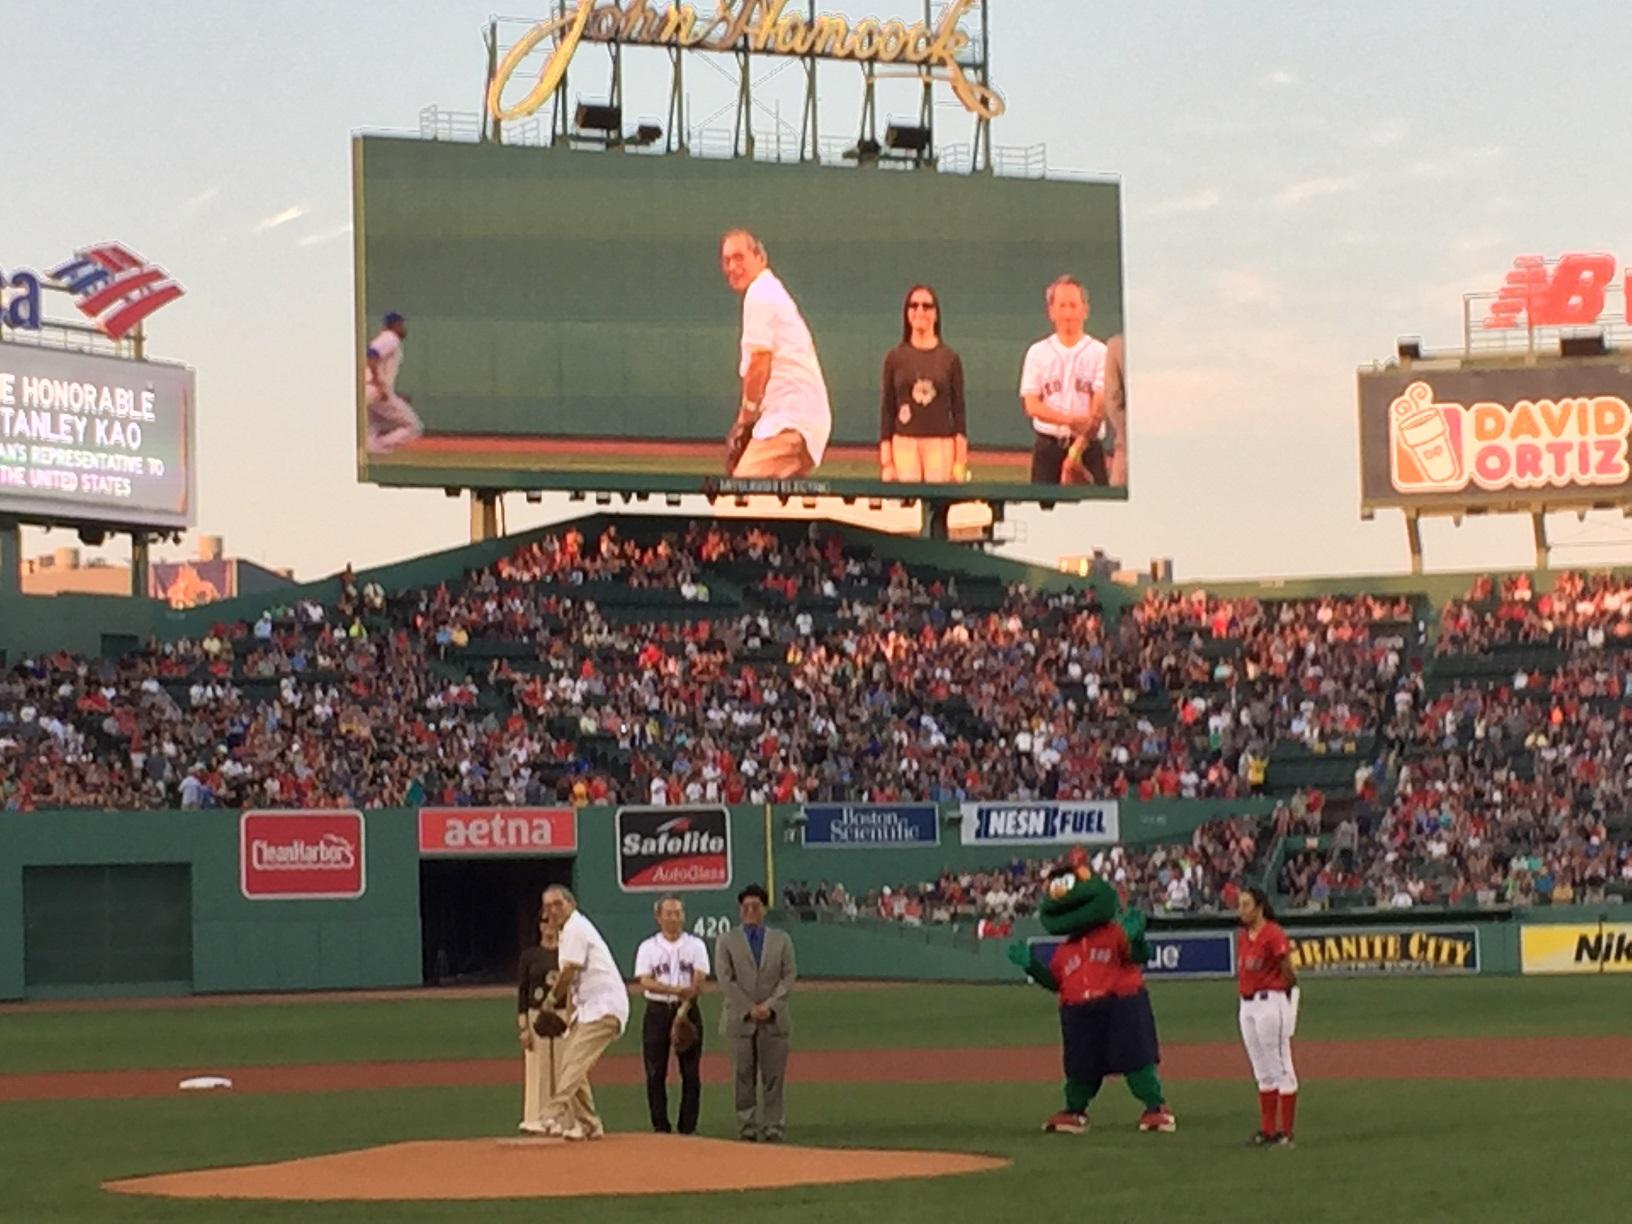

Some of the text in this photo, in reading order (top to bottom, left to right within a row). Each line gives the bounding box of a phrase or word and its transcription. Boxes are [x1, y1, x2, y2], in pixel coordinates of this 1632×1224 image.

[488, 0, 1005, 120] John Hancock
[22, 376, 156, 422] HONORABLE
[95, 417, 142, 450] KAO
[1475, 400, 1625, 441] DAVID
[30, 445, 144, 475] REPRESENTATIVE
[147, 457, 165, 477] TO
[1475, 439, 1624, 481] ORTIZ
[29, 468, 78, 493] UNITED
[81, 473, 132, 498] STATES
[444, 812, 552, 847] aetna
[830, 816, 920, 842] Scientific
[842, 806, 898, 825] Boston
[989, 807, 1106, 836] NESN FUEL
[622, 830, 725, 857] Safelite
[693, 915, 731, 938] 420
